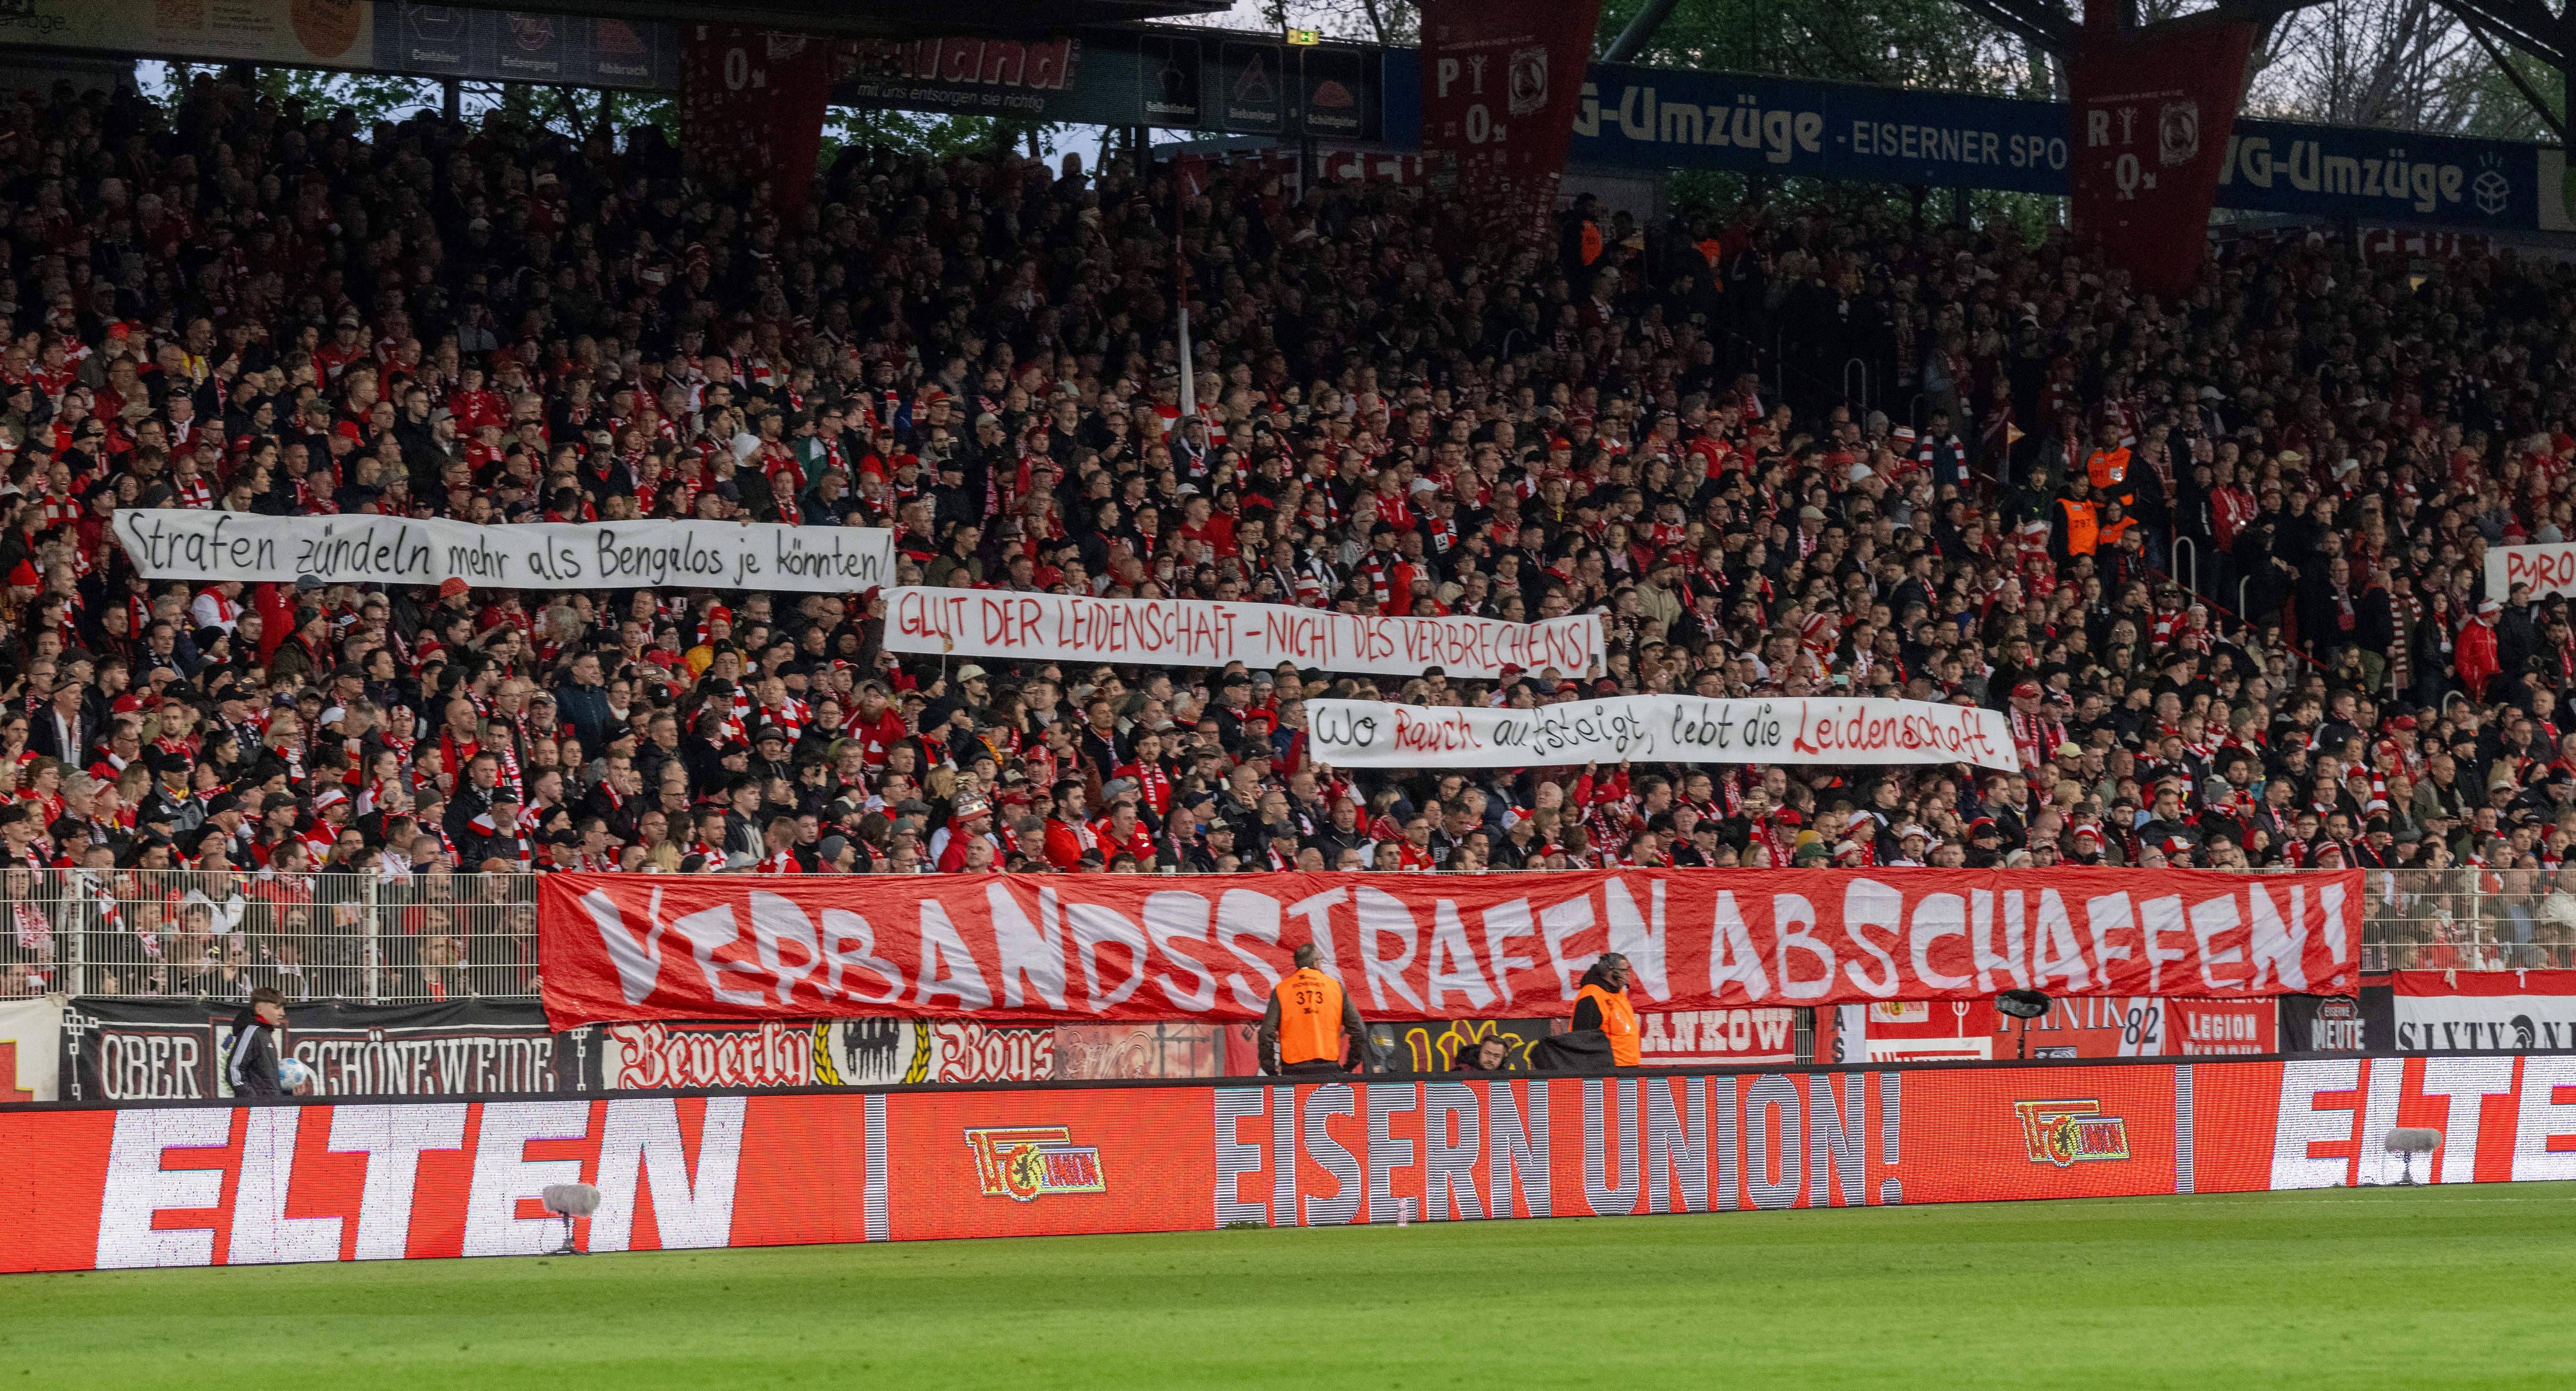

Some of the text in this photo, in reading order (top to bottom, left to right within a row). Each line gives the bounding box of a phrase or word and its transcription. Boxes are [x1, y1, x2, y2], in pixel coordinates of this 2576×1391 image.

[882, 86, 907, 99] uns
[911, 87, 978, 107] entsorgen
[981, 93, 1001, 106] sie
[1003, 94, 1045, 113] richtig
[1852, 120, 2001, 165] EISERNER
[129, 512, 276, 571] Strafen
[297, 524, 432, 575] zündeln
[448, 534, 509, 580] mehr
[528, 535, 582, 581] als
[598, 528, 724, 586] Bengalos
[733, 537, 761, 586] je
[2507, 550, 2575, 595] PYRO
[900, 591, 968, 638] GLUT
[982, 596, 1045, 647] DER
[1057, 598, 1237, 660] LEIDENSCHAFT
[1266, 611, 1341, 667] NICHT
[1352, 614, 1395, 663] DES
[1317, 700, 2011, 764] Wo Rauch aufsteigt, lebt die Leidenschaft.
[579, 875, 2346, 1013] VERBANDSSTRAFEN ABSCHAFFEN!
[1296, 990, 1323, 1005] 373
[1636, 1007, 1794, 1052] ANKOW
[2125, 1006, 2159, 1045] 82
[2187, 1011, 2257, 1041] LEGION
[2311, 1018, 2365, 1052] MEUTE
[101, 1030, 554, 1100] OBER SCHÖNEWEIDE
[610, 1019, 810, 1089] Beverly
[934, 1018, 1055, 1084] Boys
[1214, 1073, 1904, 1230] EISERN UNION!
[96, 1097, 747, 1270] ELTEN
